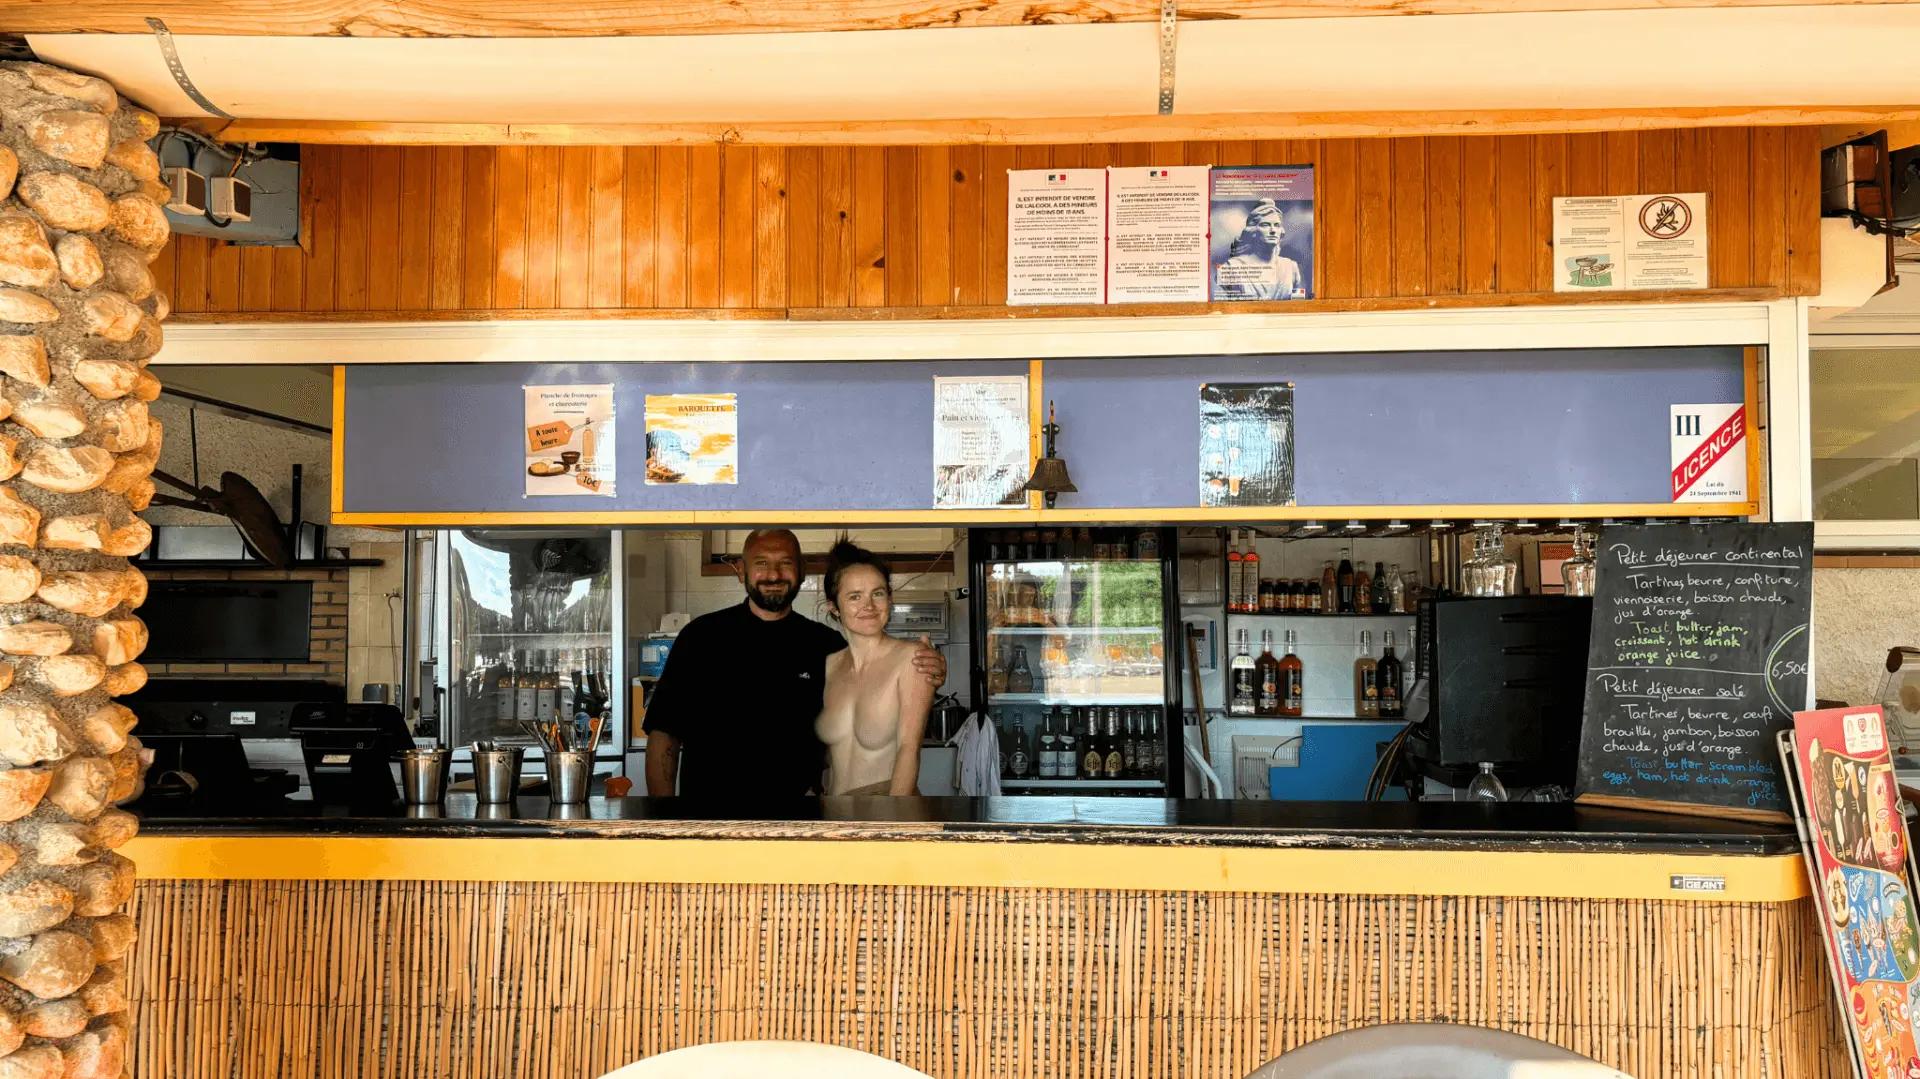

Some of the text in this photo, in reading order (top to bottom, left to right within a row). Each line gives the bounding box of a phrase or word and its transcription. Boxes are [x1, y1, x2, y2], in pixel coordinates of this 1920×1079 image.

[542, 427, 558, 435] toute
[540, 438, 558, 447] heure
[1674, 416, 1742, 493] LICENCE
[1608, 543, 1803, 567] Petit déjeuner continental
[1687, 573, 1731, 590] beurre,
[1734, 573, 1799, 591] confiture,
[1613, 589, 1786, 606] viennoiserie, boisson chaude,
[1614, 609, 1634, 624] jus
[1676, 620, 1714, 635] butter,
[1716, 622, 1749, 637] jam,
[1614, 634, 1740, 647] croissant, hot drink
[1618, 651, 1659, 664] orange
[1772, 661, 1808, 680] 6,50€
[1596, 673, 1746, 702] Petit déjeuner salé
[1620, 704, 1684, 723] Tartines,
[1687, 707, 1738, 724] beurre,
[1663, 723, 1717, 742] jambon,
[1718, 724, 1760, 737] boisson
[1603, 739, 1658, 754] chaude,
[1670, 772, 1690, 782] hot
